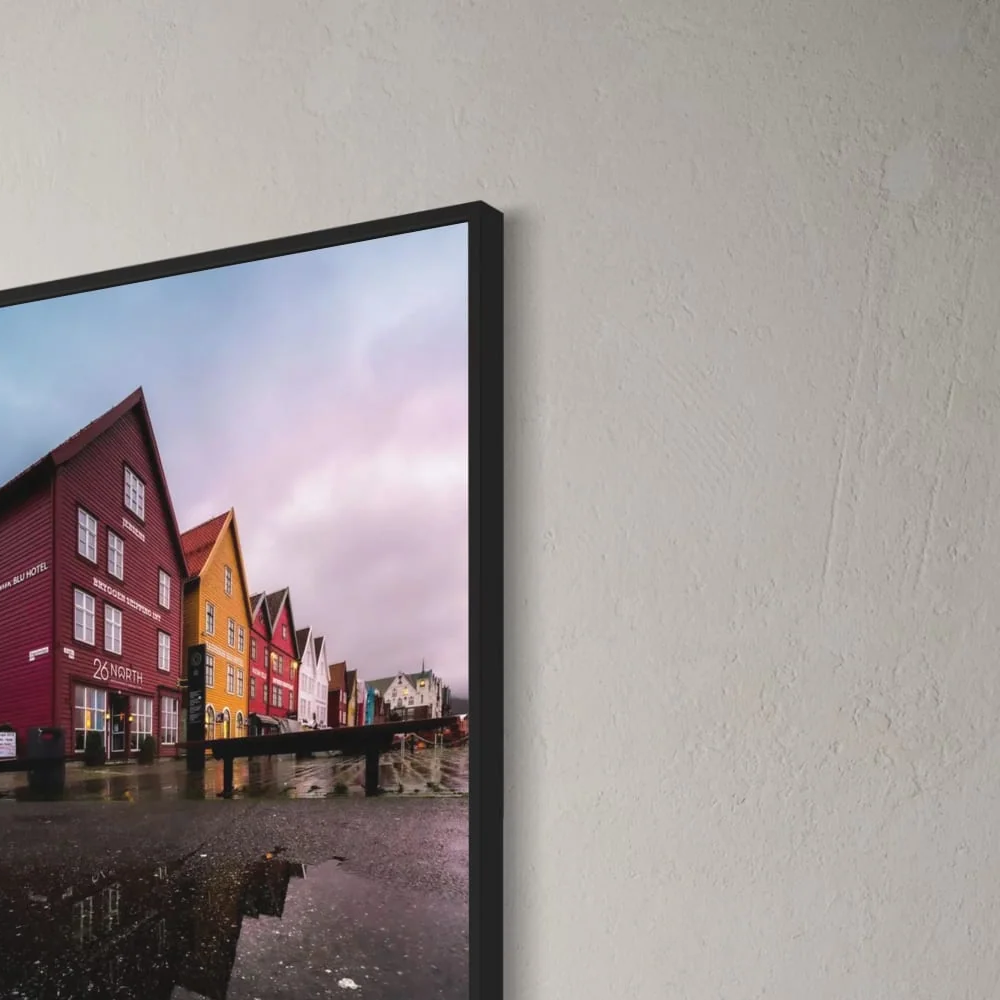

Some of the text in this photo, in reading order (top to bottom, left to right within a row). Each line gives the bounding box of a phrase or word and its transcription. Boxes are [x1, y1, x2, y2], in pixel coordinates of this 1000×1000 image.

[26, 561, 48, 579] HOTEL
[93, 658, 109, 681] 26
[110, 663, 143, 685] NORTH
